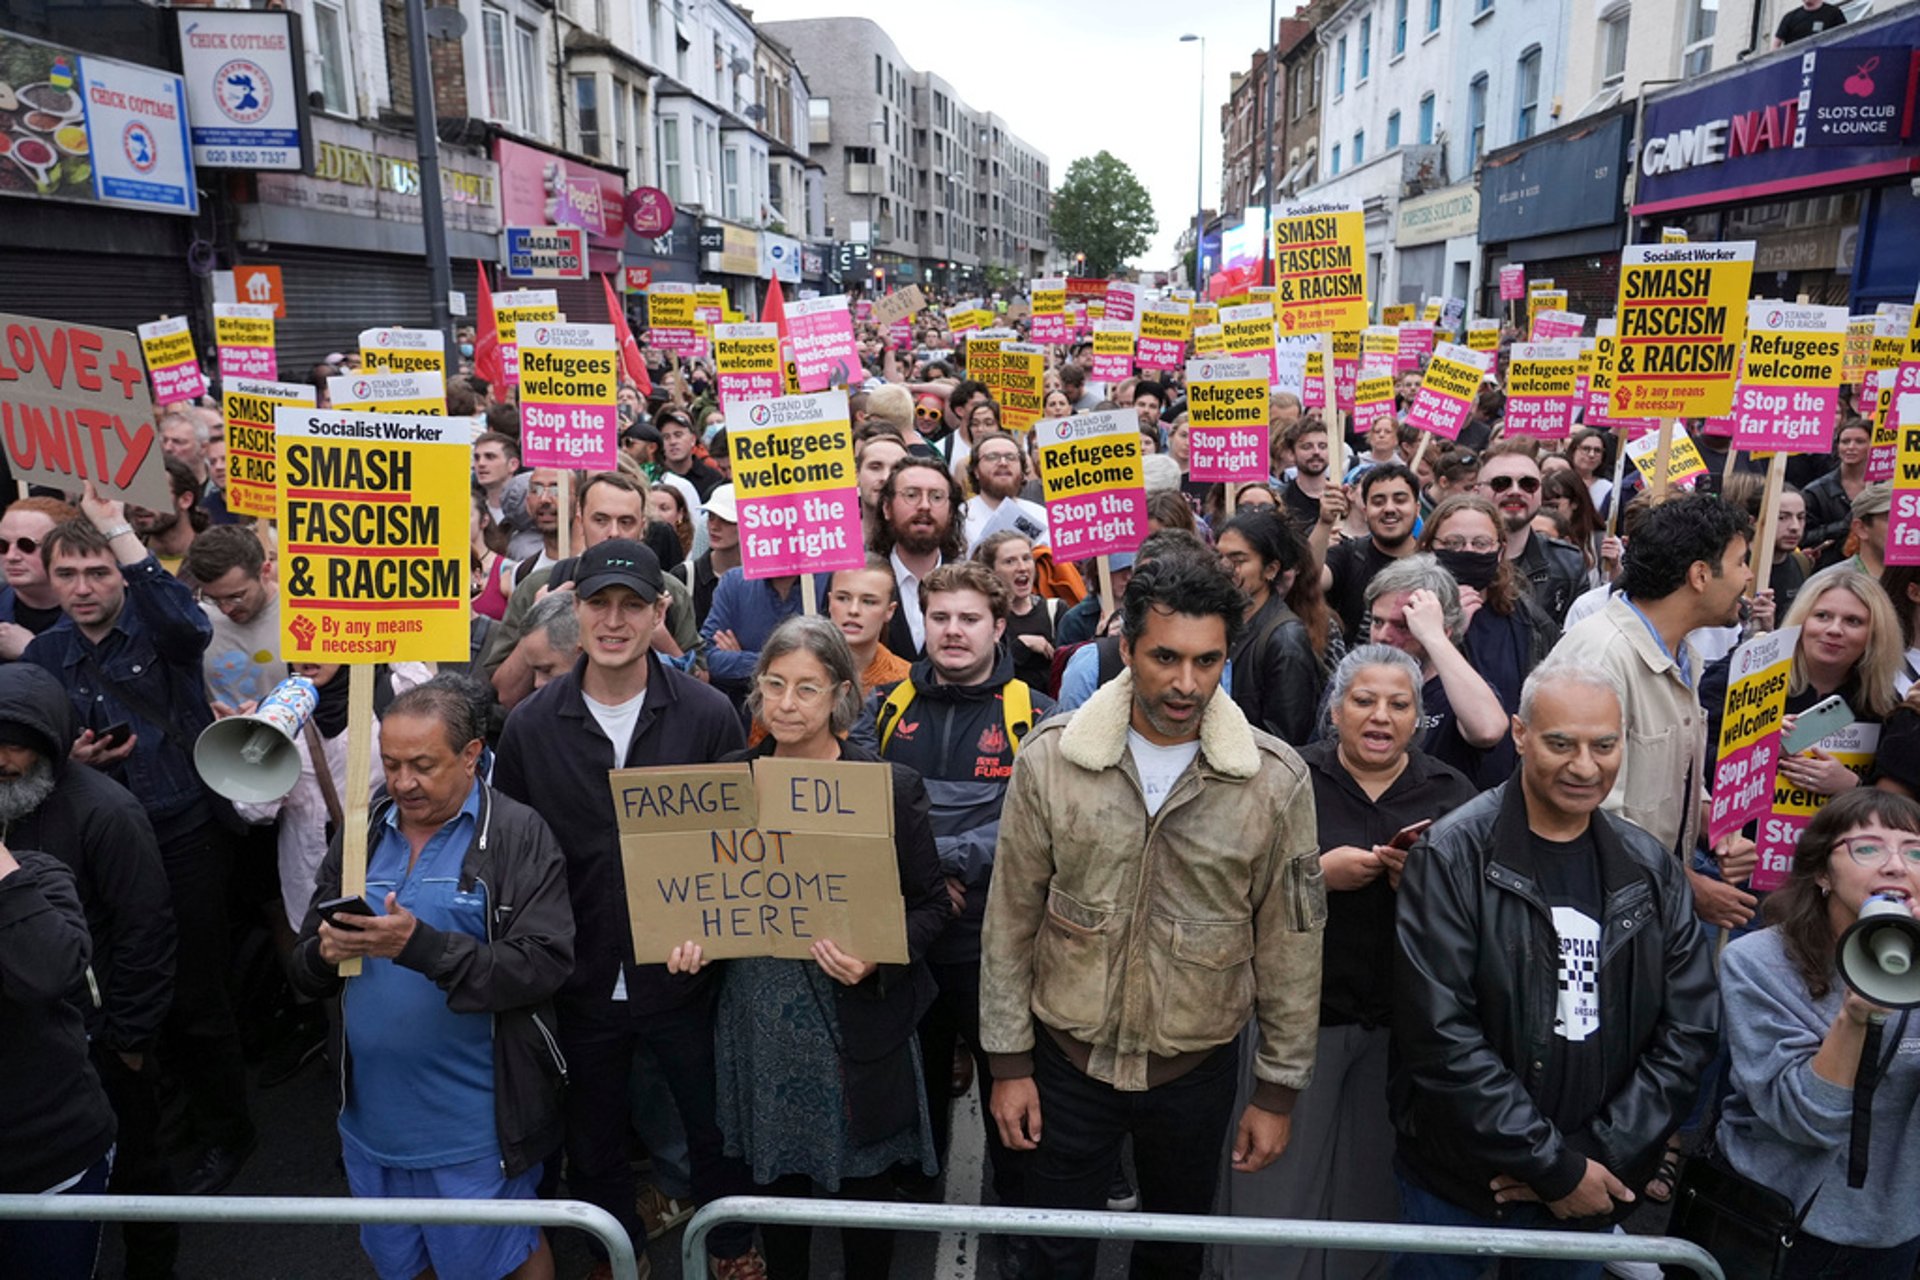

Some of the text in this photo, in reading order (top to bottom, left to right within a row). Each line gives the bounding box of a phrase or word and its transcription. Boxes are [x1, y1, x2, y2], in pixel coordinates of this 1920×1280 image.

[190, 33, 285, 50] CHICK COTTAGE
[90, 87, 176, 120] CHICK COTTAGE
[1818, 105, 1895, 119] SLOTS CLUB
[1642, 98, 1801, 176] GAME NAT
[1833, 121, 1887, 134] LOUNGE
[207, 150, 227, 162] 020
[230, 150, 257, 163] 8520
[1278, 218, 1337, 244] SMASH
[518, 236, 571, 250] MAGAZIN
[512, 255, 579, 269] ROMANESC
[1280, 245, 1352, 273] FASCISM
[1643, 249, 1736, 263] Socialist Worker
[1282, 280, 1294, 301] &
[1300, 274, 1362, 300] RACISM
[1625, 269, 1712, 298] SMASH
[650, 294, 685, 305] Oppose
[651, 305, 683, 317] Tommy
[652, 317, 693, 326] Robinson
[1621, 307, 1727, 336] FASCISM
[1784, 311, 1824, 320] STAND UP
[218, 319, 271, 333] Refugees
[1224, 323, 1271, 335] Refugees
[1785, 320, 1827, 329] TO RACISM
[146, 334, 189, 353] Refugees
[220, 332, 268, 343] welcome
[792, 331, 851, 349] Refugees
[1226, 337, 1270, 348] welcome
[1750, 335, 1840, 359] Refugees
[0, 324, 104, 391] LOVE
[149, 349, 191, 365] welcome
[221, 348, 269, 362] Stop the
[719, 343, 775, 356] Refugees
[796, 345, 852, 363] welcome
[1618, 344, 1736, 373] & RACISM
[222, 359, 269, 374] far right
[365, 352, 441, 373] Refugees
[523, 352, 611, 377] Refugees
[721, 356, 773, 368] welcome
[799, 362, 829, 377] here
[1431, 359, 1480, 384] Refugees
[1512, 363, 1574, 378] Refugees
[1748, 360, 1832, 379] welcome
[153, 364, 196, 385] Stop the
[722, 376, 773, 389] Stop the
[1426, 374, 1471, 396] welcome
[1512, 379, 1570, 391] welcome
[157, 377, 200, 396] far right
[525, 377, 607, 397] welcome
[1191, 385, 1264, 405] Refugees
[1635, 385, 1705, 398] By any means
[770, 399, 817, 413] STAND UP
[1419, 390, 1461, 415] Stop the
[1509, 399, 1566, 415] Stop the
[1634, 401, 1685, 412] necessary
[1743, 390, 1824, 414] Stop the
[526, 407, 605, 433] Stop the
[773, 409, 823, 423] TO RACISM
[1074, 415, 1112, 427] STAND UP
[1192, 405, 1261, 421] welcome
[1412, 404, 1457, 428] far right
[1508, 414, 1564, 431] far right
[308, 418, 442, 441] Socialist Worker
[1075, 428, 1086, 437] TO
[1739, 414, 1820, 439] far right
[2, 402, 155, 490] UNITY
[526, 431, 604, 457] far right
[735, 432, 846, 460] Refugees
[1193, 431, 1258, 452] Stop the
[1045, 442, 1136, 470] Refugees
[1193, 451, 1258, 471] far right
[230, 456, 275, 482] & RAC
[286, 444, 411, 491] SMASH
[739, 462, 843, 489] welcome
[1048, 466, 1133, 492] welcome
[743, 498, 844, 531] Stop the
[1052, 494, 1134, 524] Stop the
[288, 501, 439, 546] FASCISM
[1054, 527, 1083, 547] far
[1088, 518, 1136, 542] right
[746, 526, 846, 558] far right
[288, 556, 459, 599] & RACISM
[322, 616, 423, 637] By any means
[322, 638, 396, 656] necessary
[1727, 672, 1785, 716] Refugees
[1724, 704, 1778, 748] welcome
[1716, 745, 1770, 791] Stop the
[622, 777, 855, 818] FARAGE EDL
[1712, 773, 1765, 823] far right
[1773, 787, 1828, 808] welc
[711, 828, 792, 865] NOT
[657, 869, 848, 904] WELCOME
[702, 904, 812, 938] HERE
